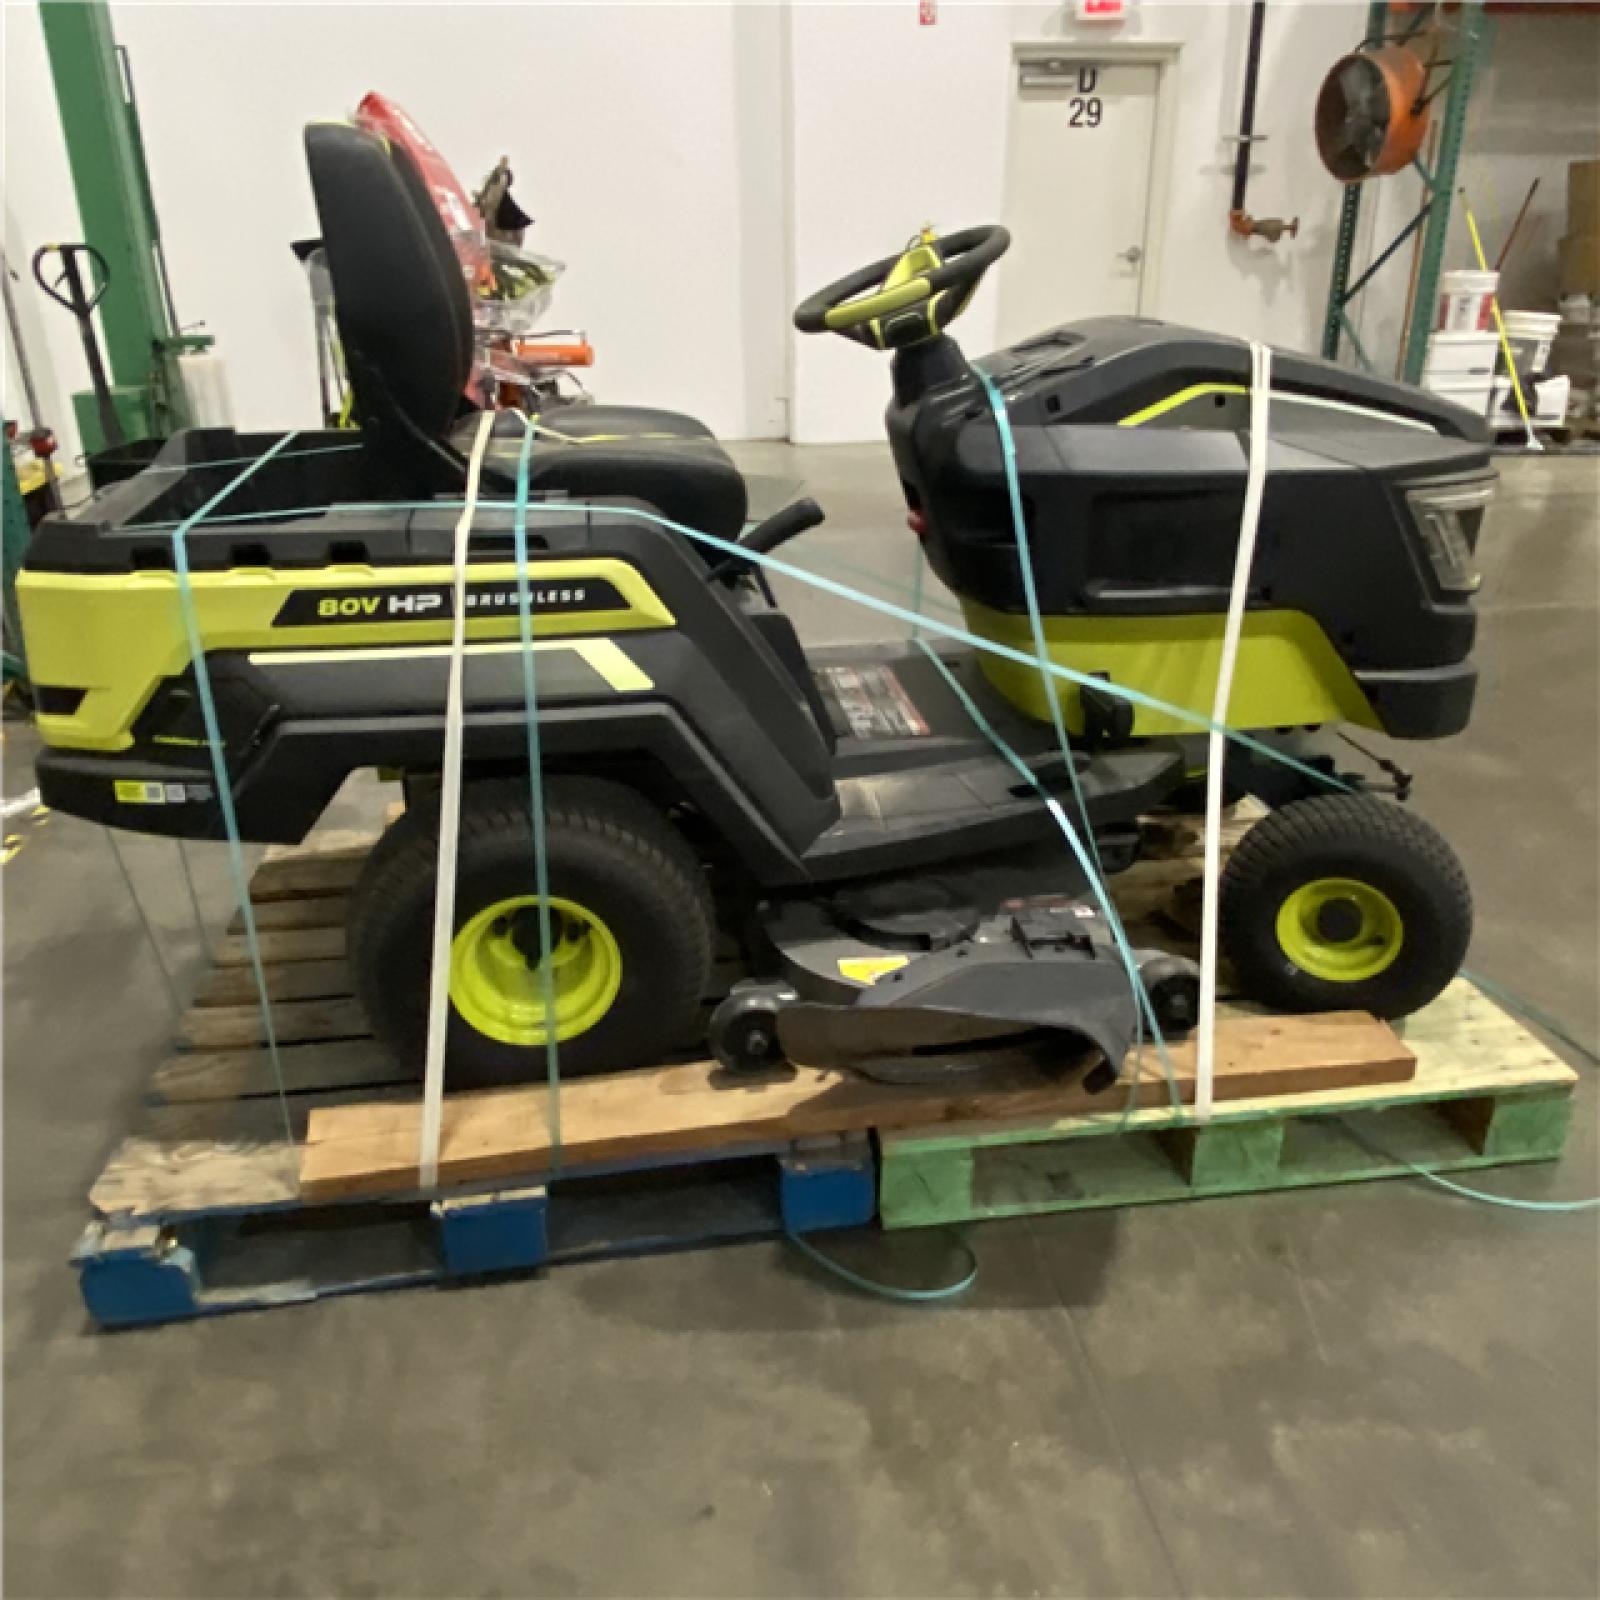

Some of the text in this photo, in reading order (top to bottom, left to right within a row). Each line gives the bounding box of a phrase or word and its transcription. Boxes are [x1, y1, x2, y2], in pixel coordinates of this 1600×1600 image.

[1068, 97, 1103, 127] 29
[318, 588, 586, 616] 80V HP BRUSLESS
